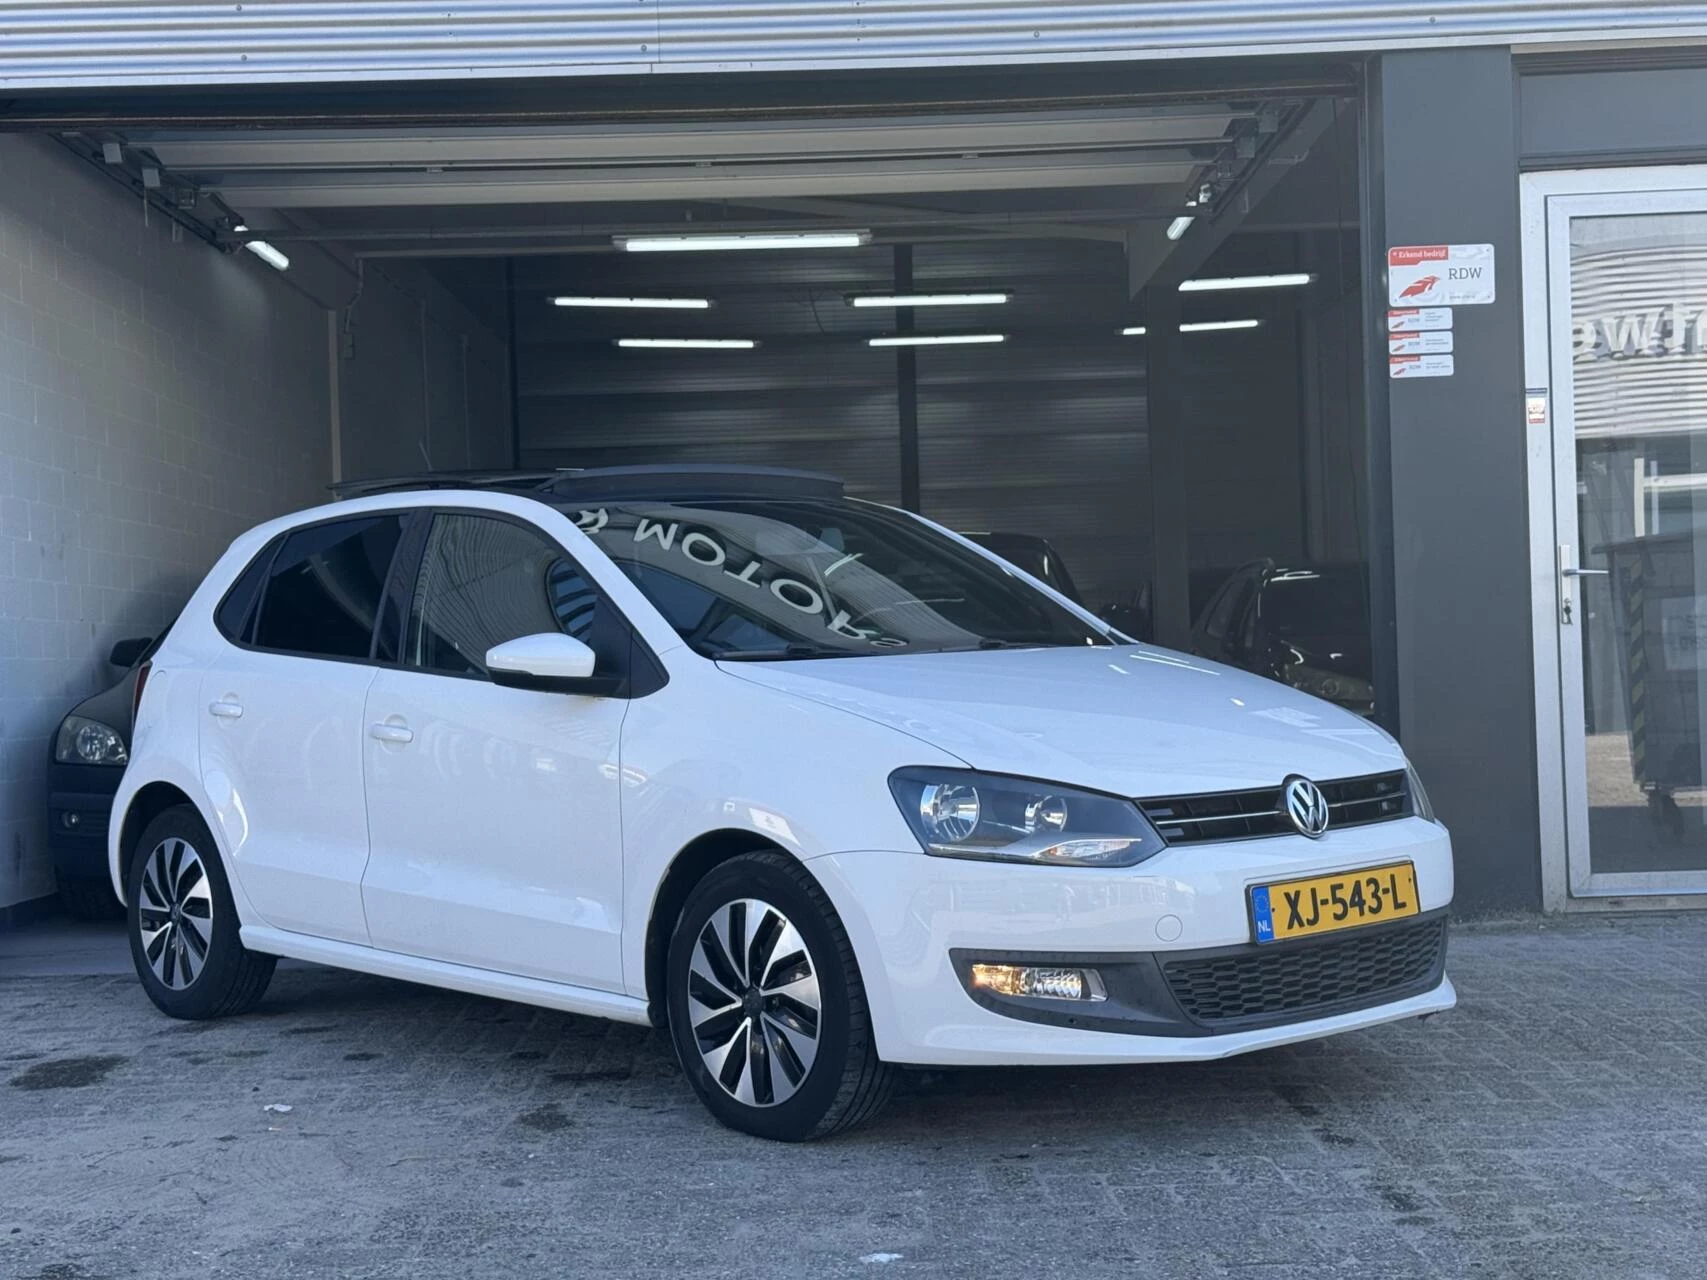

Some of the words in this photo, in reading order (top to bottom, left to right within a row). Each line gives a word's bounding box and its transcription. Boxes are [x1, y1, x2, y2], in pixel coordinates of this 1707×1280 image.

[1423, 249, 1447, 259] bedrijf
[1448, 267, 1482, 280] RDW
[1283, 873, 1407, 930] XJ-543-L
[1257, 920, 1271, 933] NL
